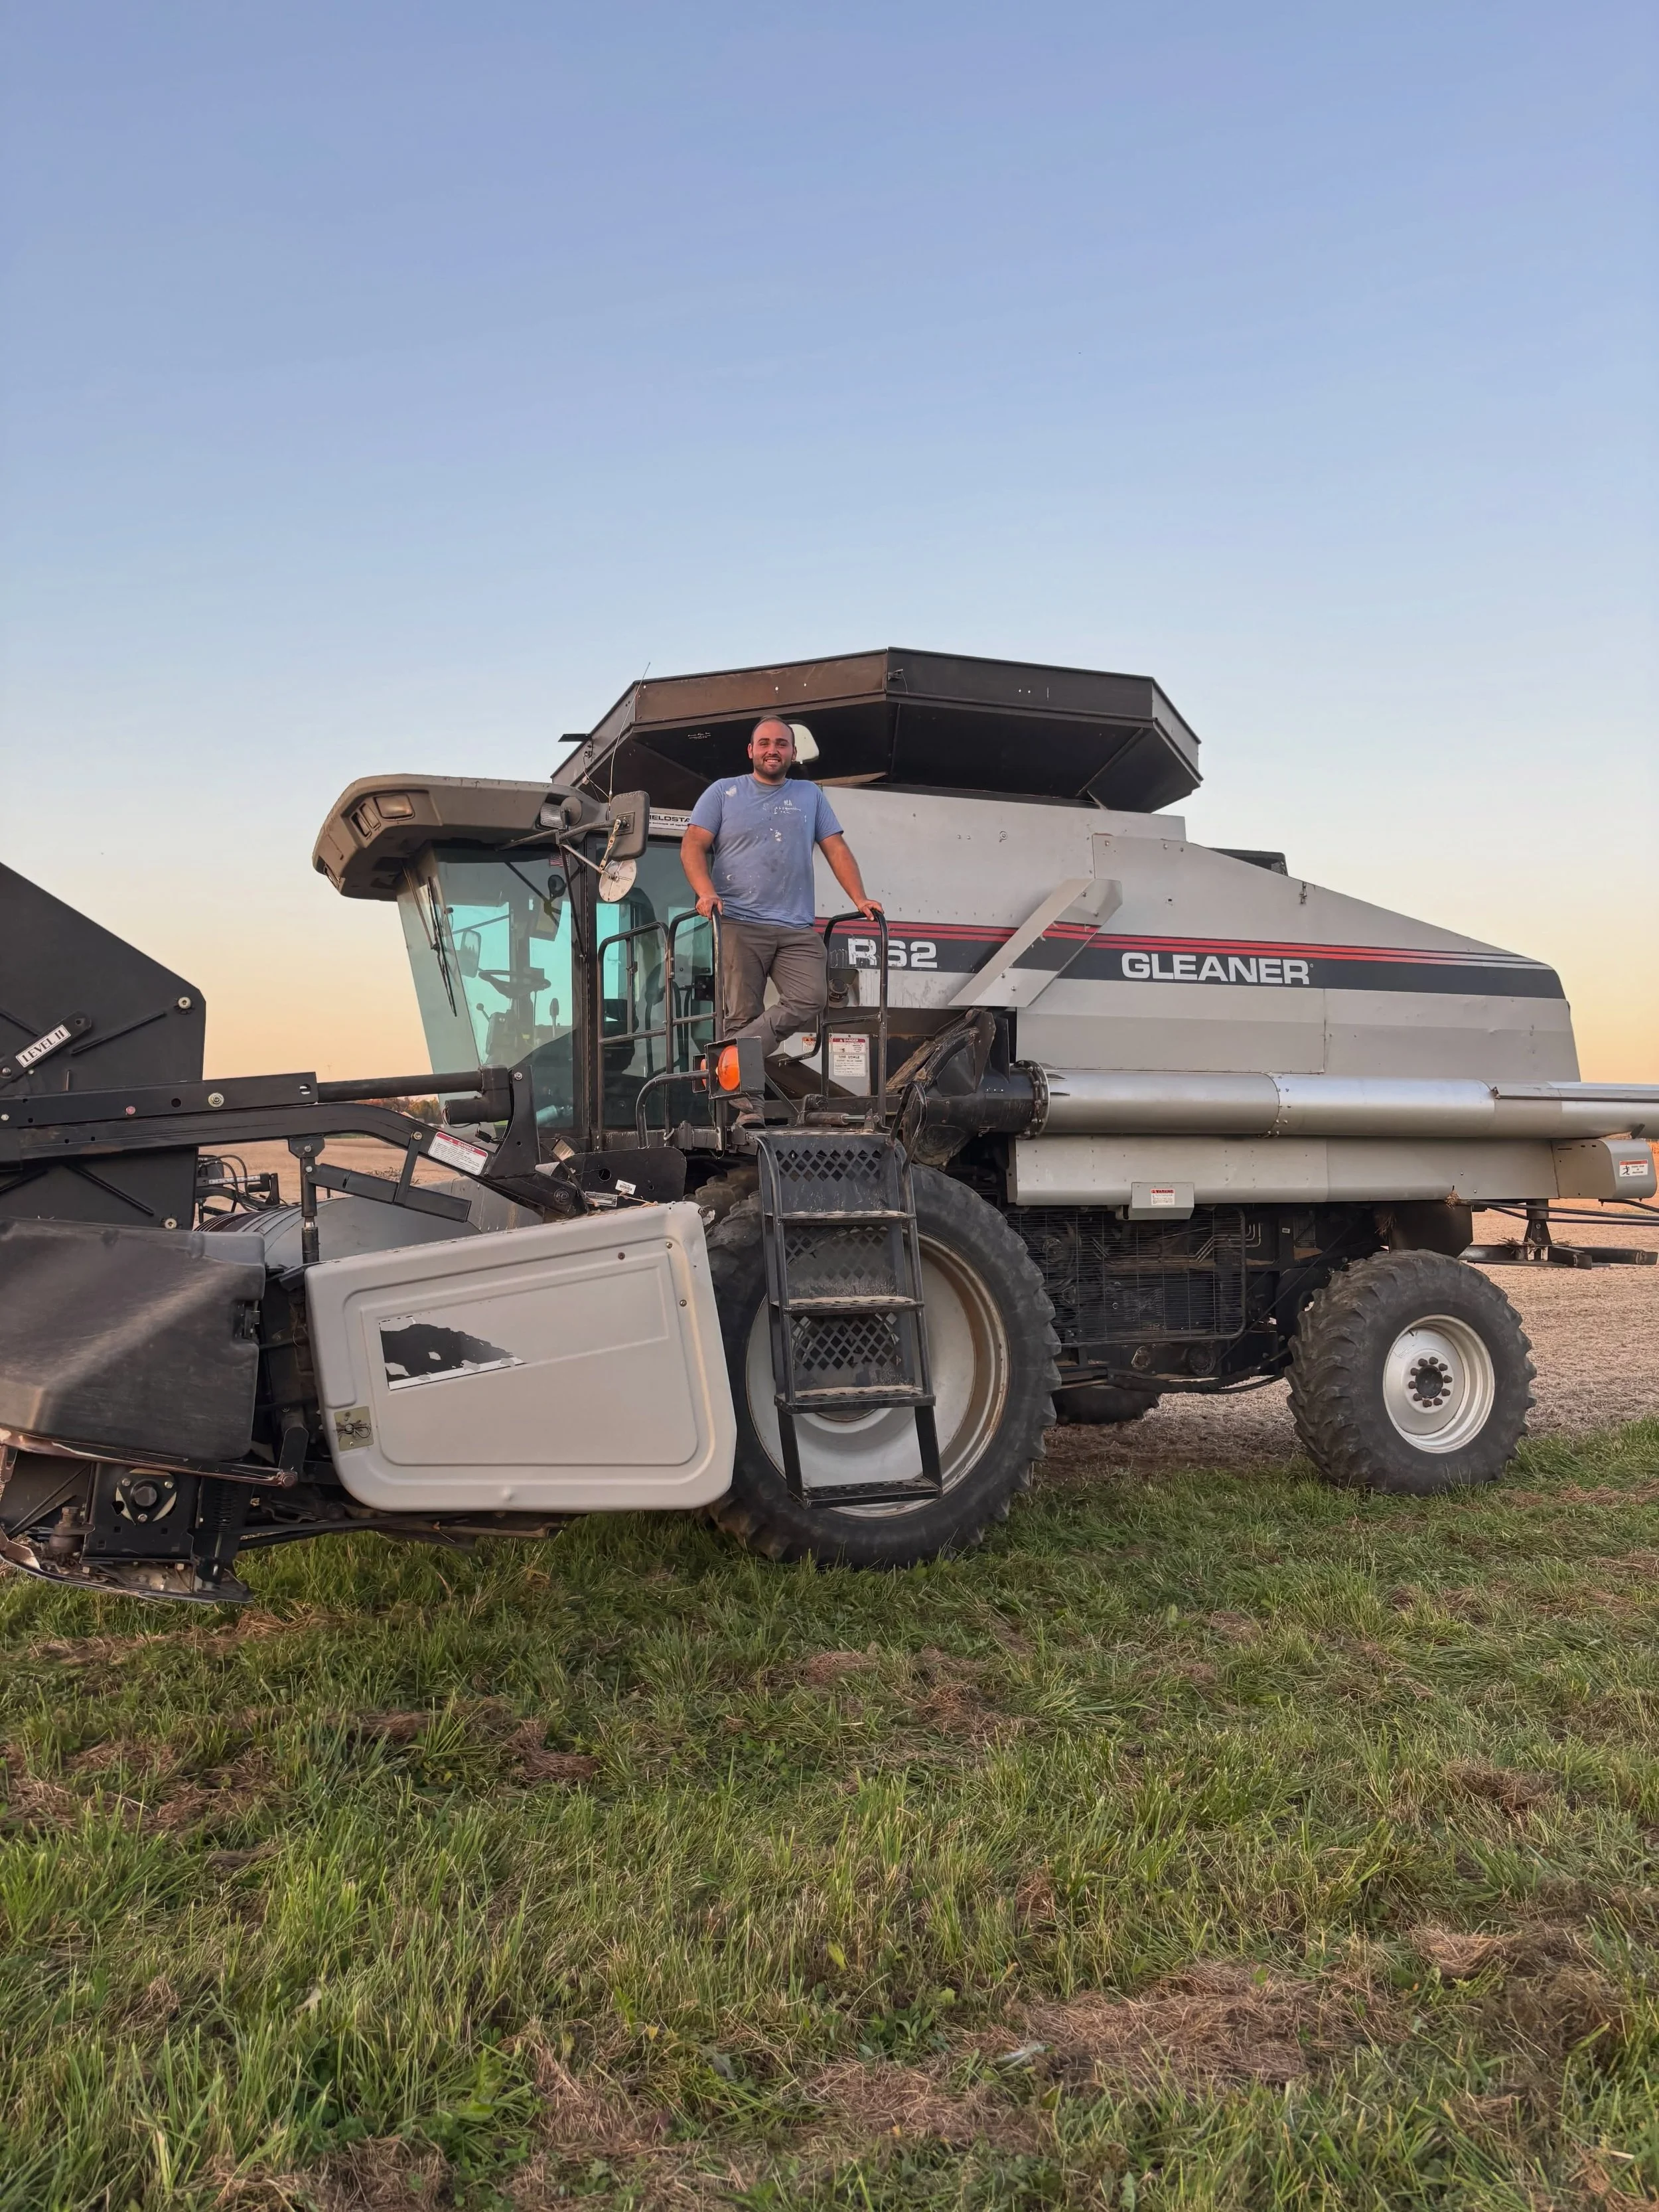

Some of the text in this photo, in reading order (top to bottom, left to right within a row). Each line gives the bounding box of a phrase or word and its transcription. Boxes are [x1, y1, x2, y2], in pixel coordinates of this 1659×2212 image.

[847, 938, 938, 968] R62
[1121, 952, 1310, 985] GLEANER
[22, 1029, 65, 1063] LEVEL II
